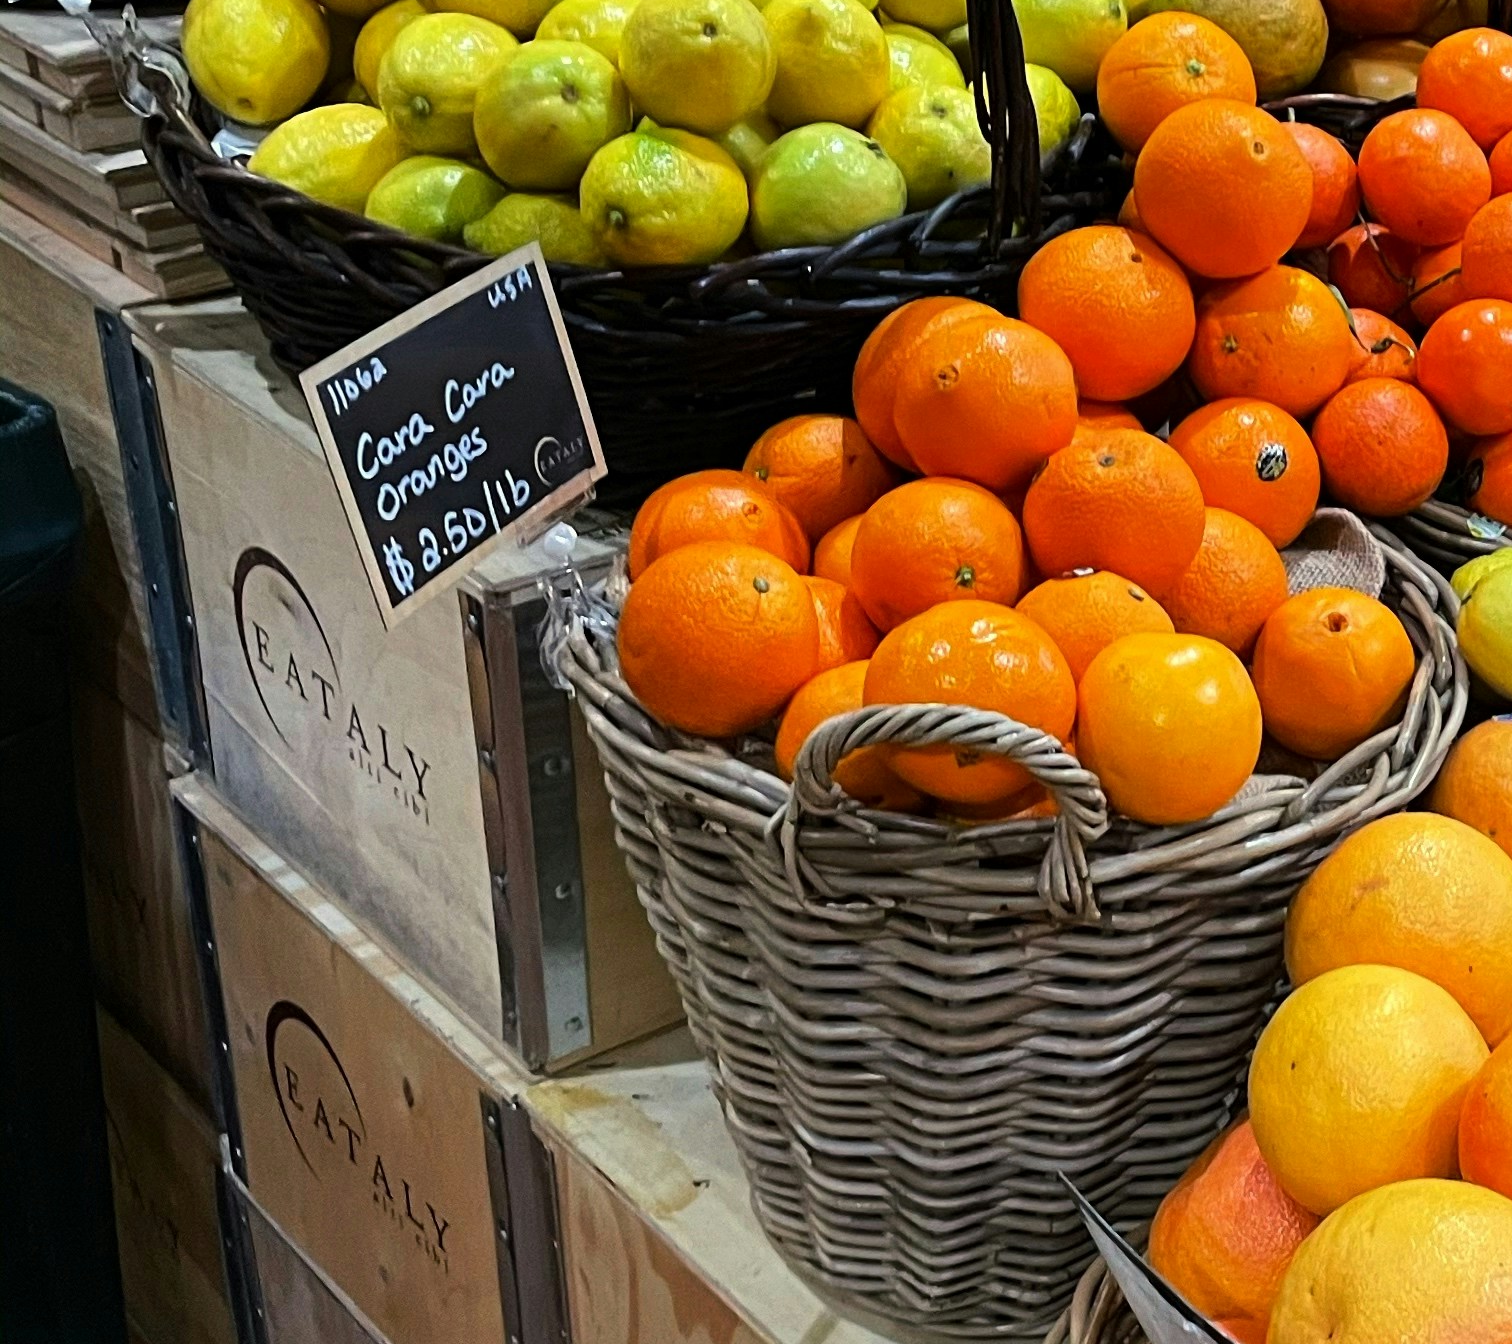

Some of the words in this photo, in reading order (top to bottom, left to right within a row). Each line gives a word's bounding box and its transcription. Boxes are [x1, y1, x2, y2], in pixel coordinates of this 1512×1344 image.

[355, 413, 434, 480] Cara
[444, 361, 515, 424] Cara
[251, 620, 432, 800] EATALY
[284, 1061, 450, 1253] EATALY
